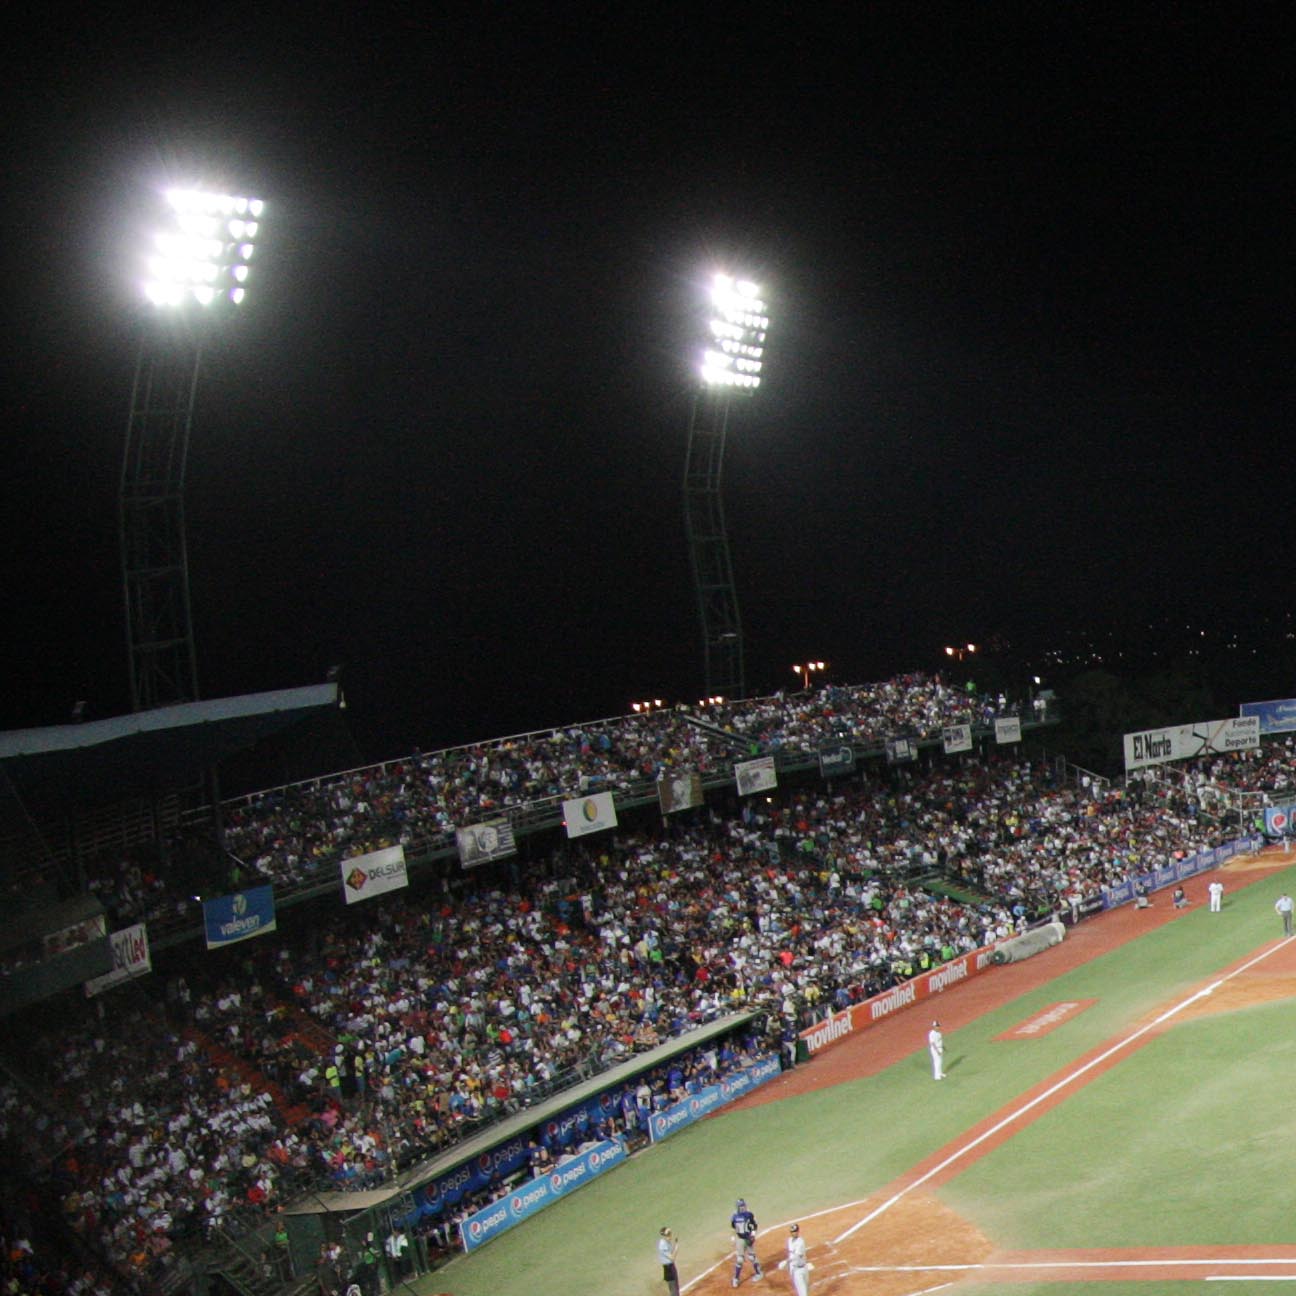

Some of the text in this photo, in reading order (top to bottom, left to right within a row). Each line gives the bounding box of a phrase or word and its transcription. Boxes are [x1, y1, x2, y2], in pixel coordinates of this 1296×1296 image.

[1133, 733, 1171, 760] El Norte
[929, 958, 968, 993] movilnet
[872, 983, 916, 1020] movilnet
[601, 1142, 623, 1162] pepsi
[440, 1168, 472, 1199] pepsi
[563, 1164, 587, 1185] pepsi
[523, 1185, 548, 1208] pepsi
[482, 1208, 508, 1233] pepsi
